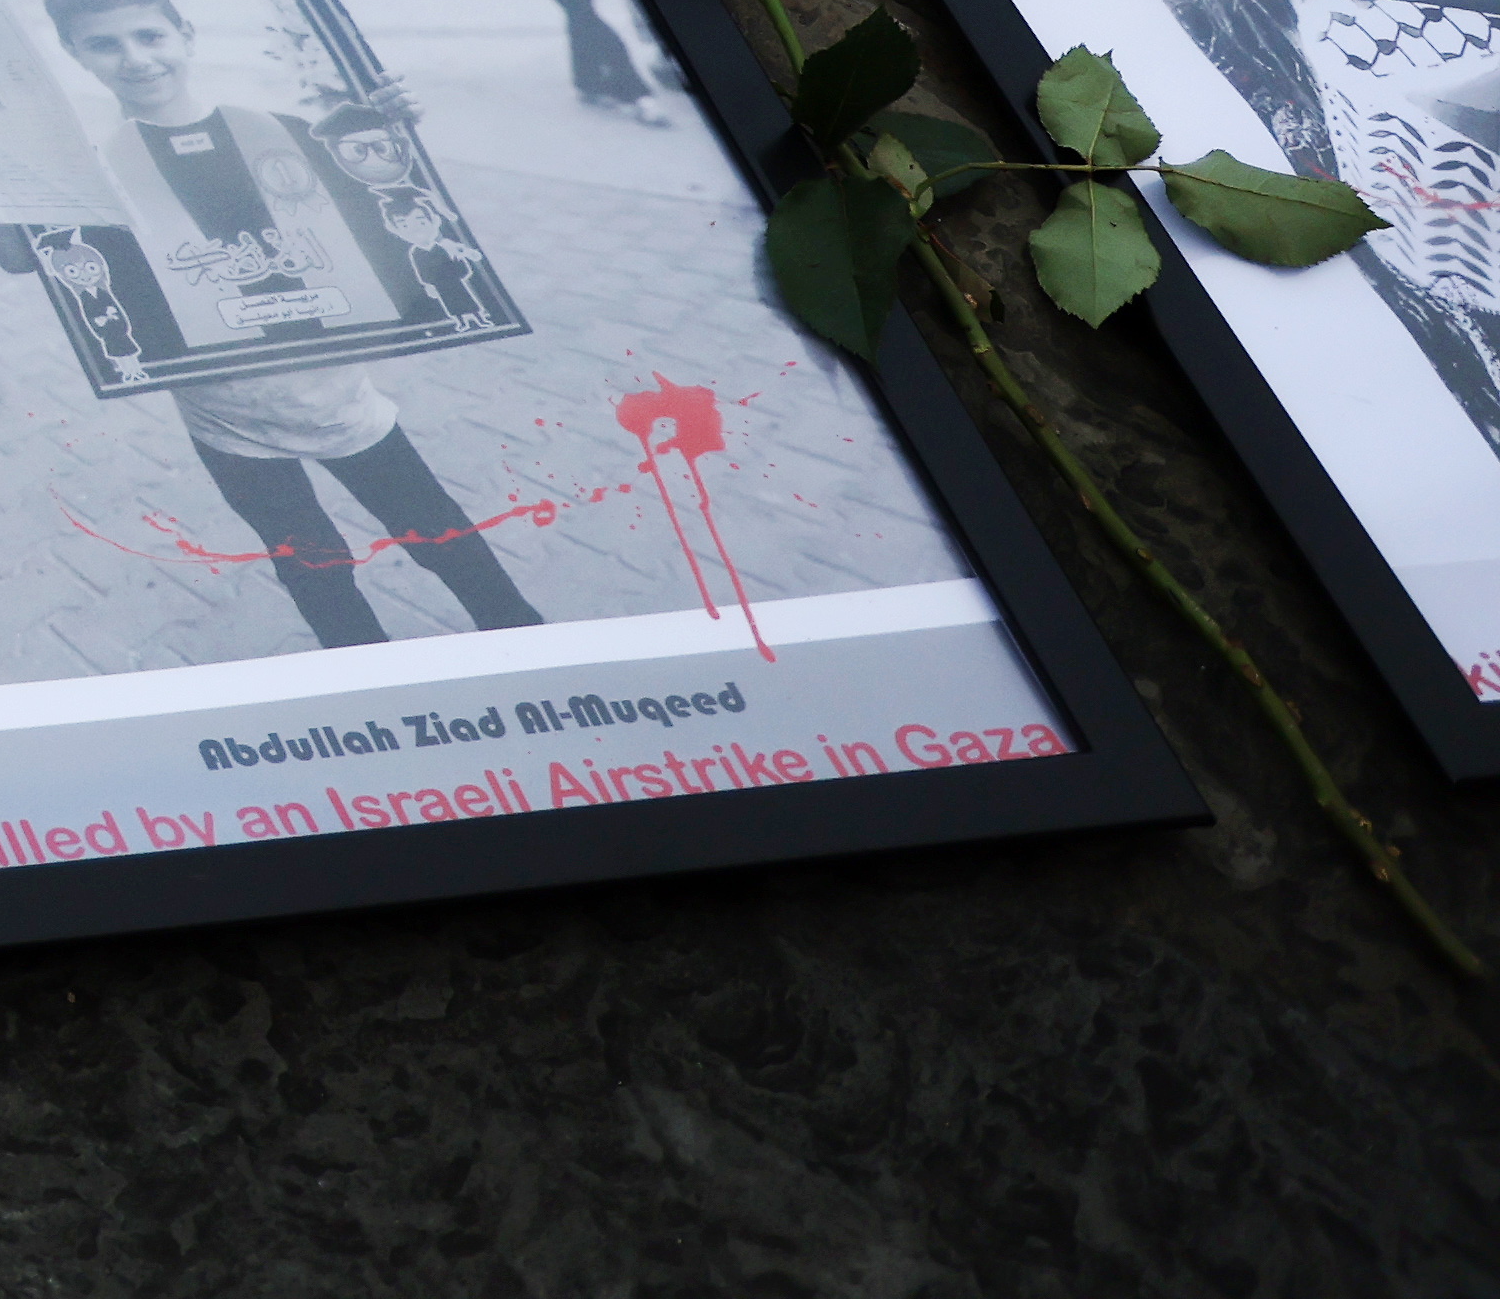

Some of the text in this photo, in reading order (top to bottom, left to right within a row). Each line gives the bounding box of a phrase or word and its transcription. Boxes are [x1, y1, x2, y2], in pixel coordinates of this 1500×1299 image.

[199, 682, 746, 770] Abdullah Ziad Al-Muqeed
[138, 809, 214, 847] by
[239, 804, 318, 837] an
[327, 769, 531, 829] Israeli
[550, 744, 813, 808] Airstrike
[819, 736, 888, 776] in
[896, 725, 1067, 768] Gaza
